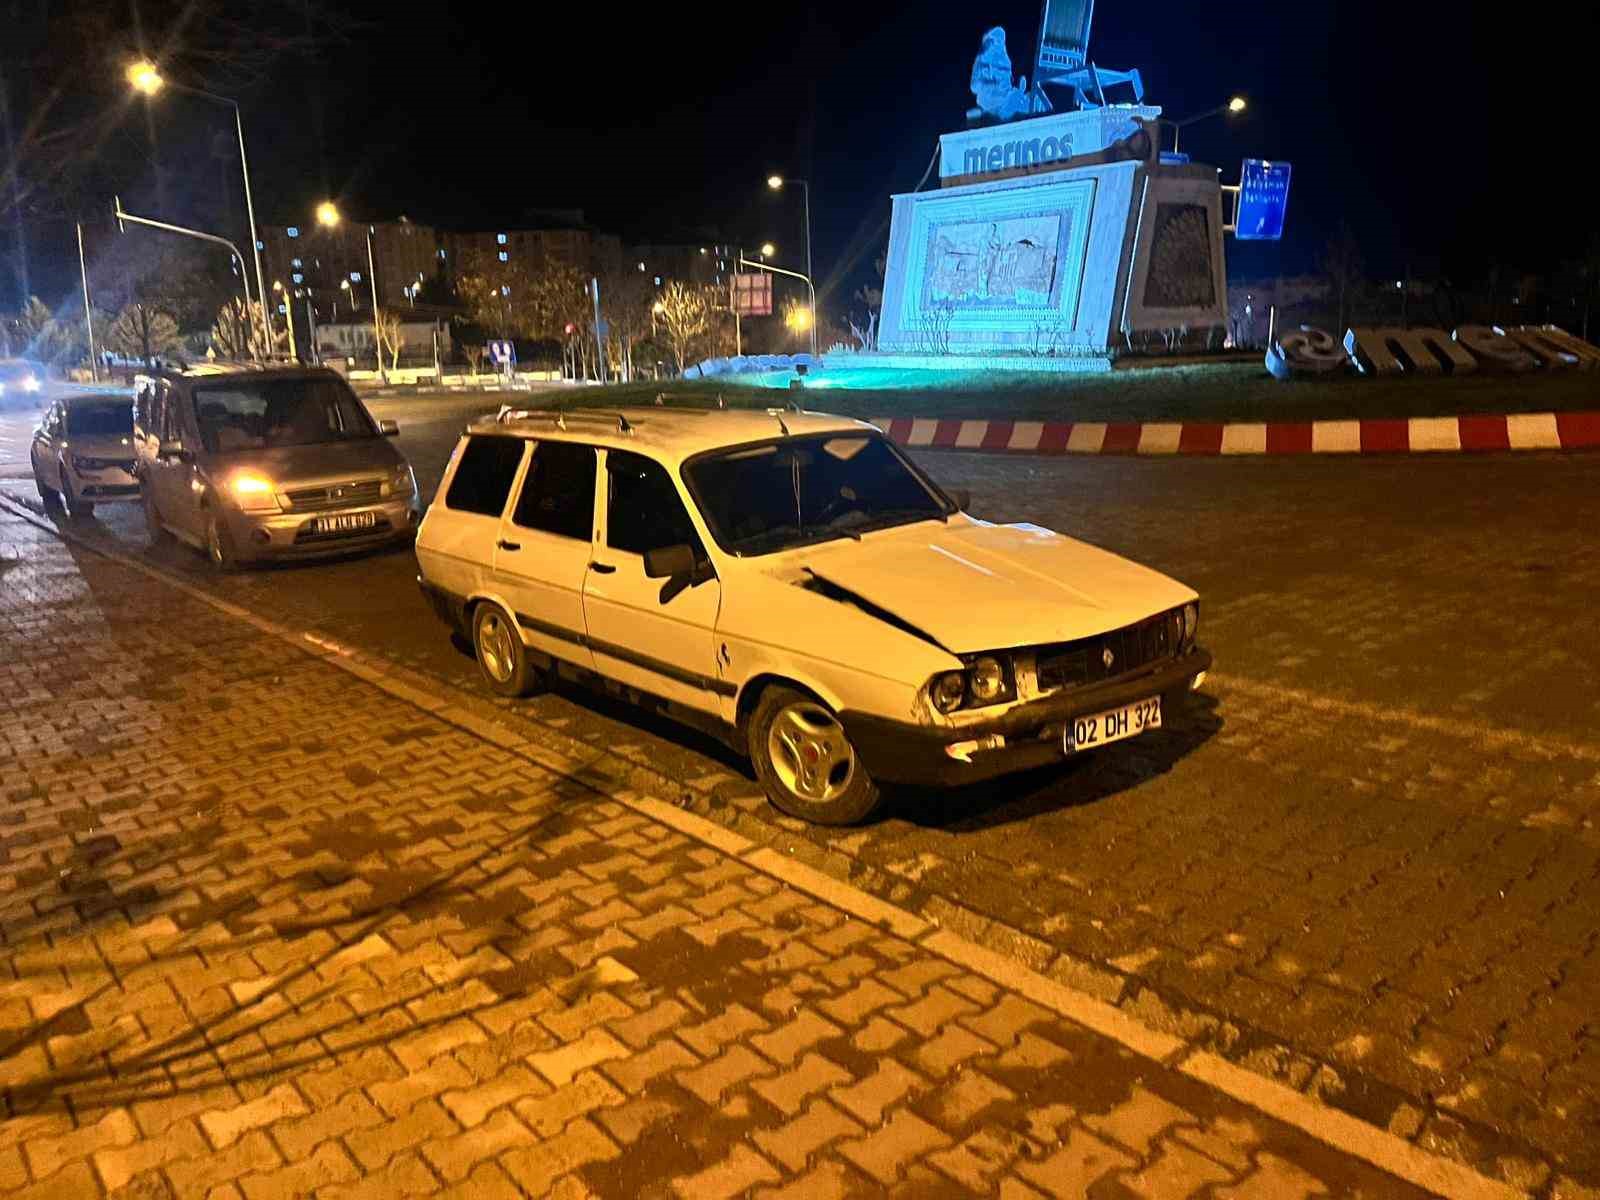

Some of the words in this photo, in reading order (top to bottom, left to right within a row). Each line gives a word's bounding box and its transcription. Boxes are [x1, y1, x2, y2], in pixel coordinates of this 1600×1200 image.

[963, 133, 1074, 175] merinos
[1076, 719, 1098, 745] 02
[1105, 709, 1129, 738] DH
[1135, 699, 1159, 729] 322
